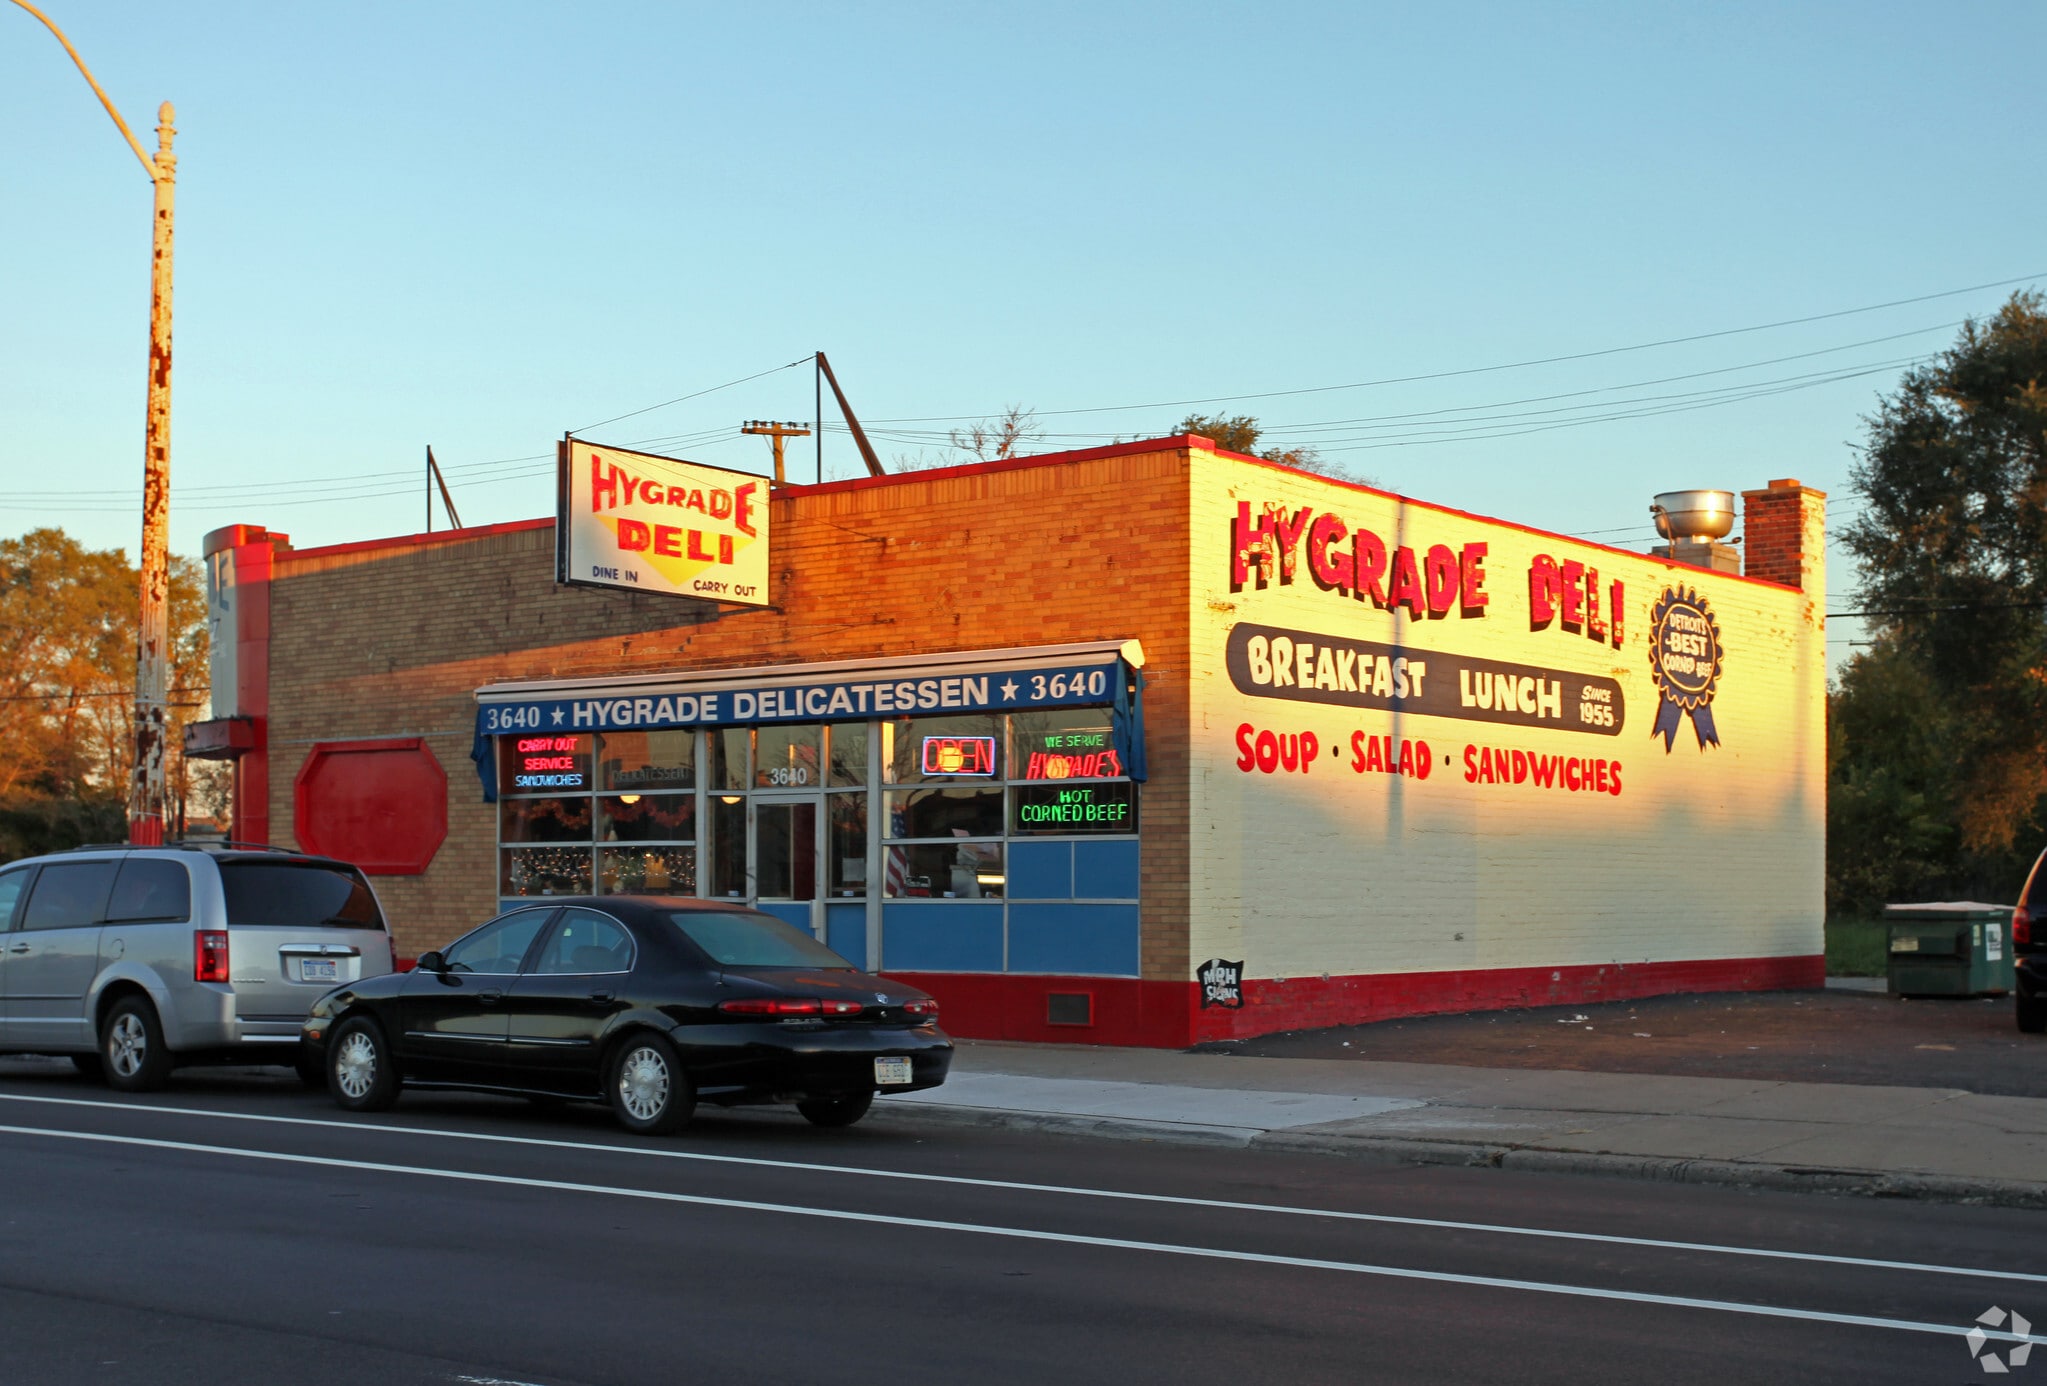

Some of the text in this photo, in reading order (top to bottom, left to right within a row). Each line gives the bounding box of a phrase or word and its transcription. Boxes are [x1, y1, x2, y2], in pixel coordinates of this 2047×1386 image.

[591, 453, 757, 539] HYGRADE
[617, 517, 734, 565] DELI
[592, 565, 639, 583] DINE IN
[1230, 500, 1625, 650] HYGRADE DELI
[693, 579, 757, 597] CARRY OUT
[1665, 631, 1708, 657] BEST
[1247, 635, 1562, 719] BREAKFAST LUNCH
[487, 671, 1106, 730] 3640 HYGRADE DELICATESSEN 3640
[1580, 702, 1614, 727] 1955
[517, 737, 578, 753] CARRY OUT
[1044, 734, 1104, 748] WE SERVE
[524, 756, 574, 771] SERVICE
[925, 738, 994, 773] OPEN
[1235, 722, 1622, 797] SOUP SALAD SANDWICHES
[515, 773, 583, 787] SANDWICHES
[770, 767, 808, 786] 3640
[1060, 789, 1092, 803] HOT
[1021, 803, 1128, 822] CORNED BEEF
